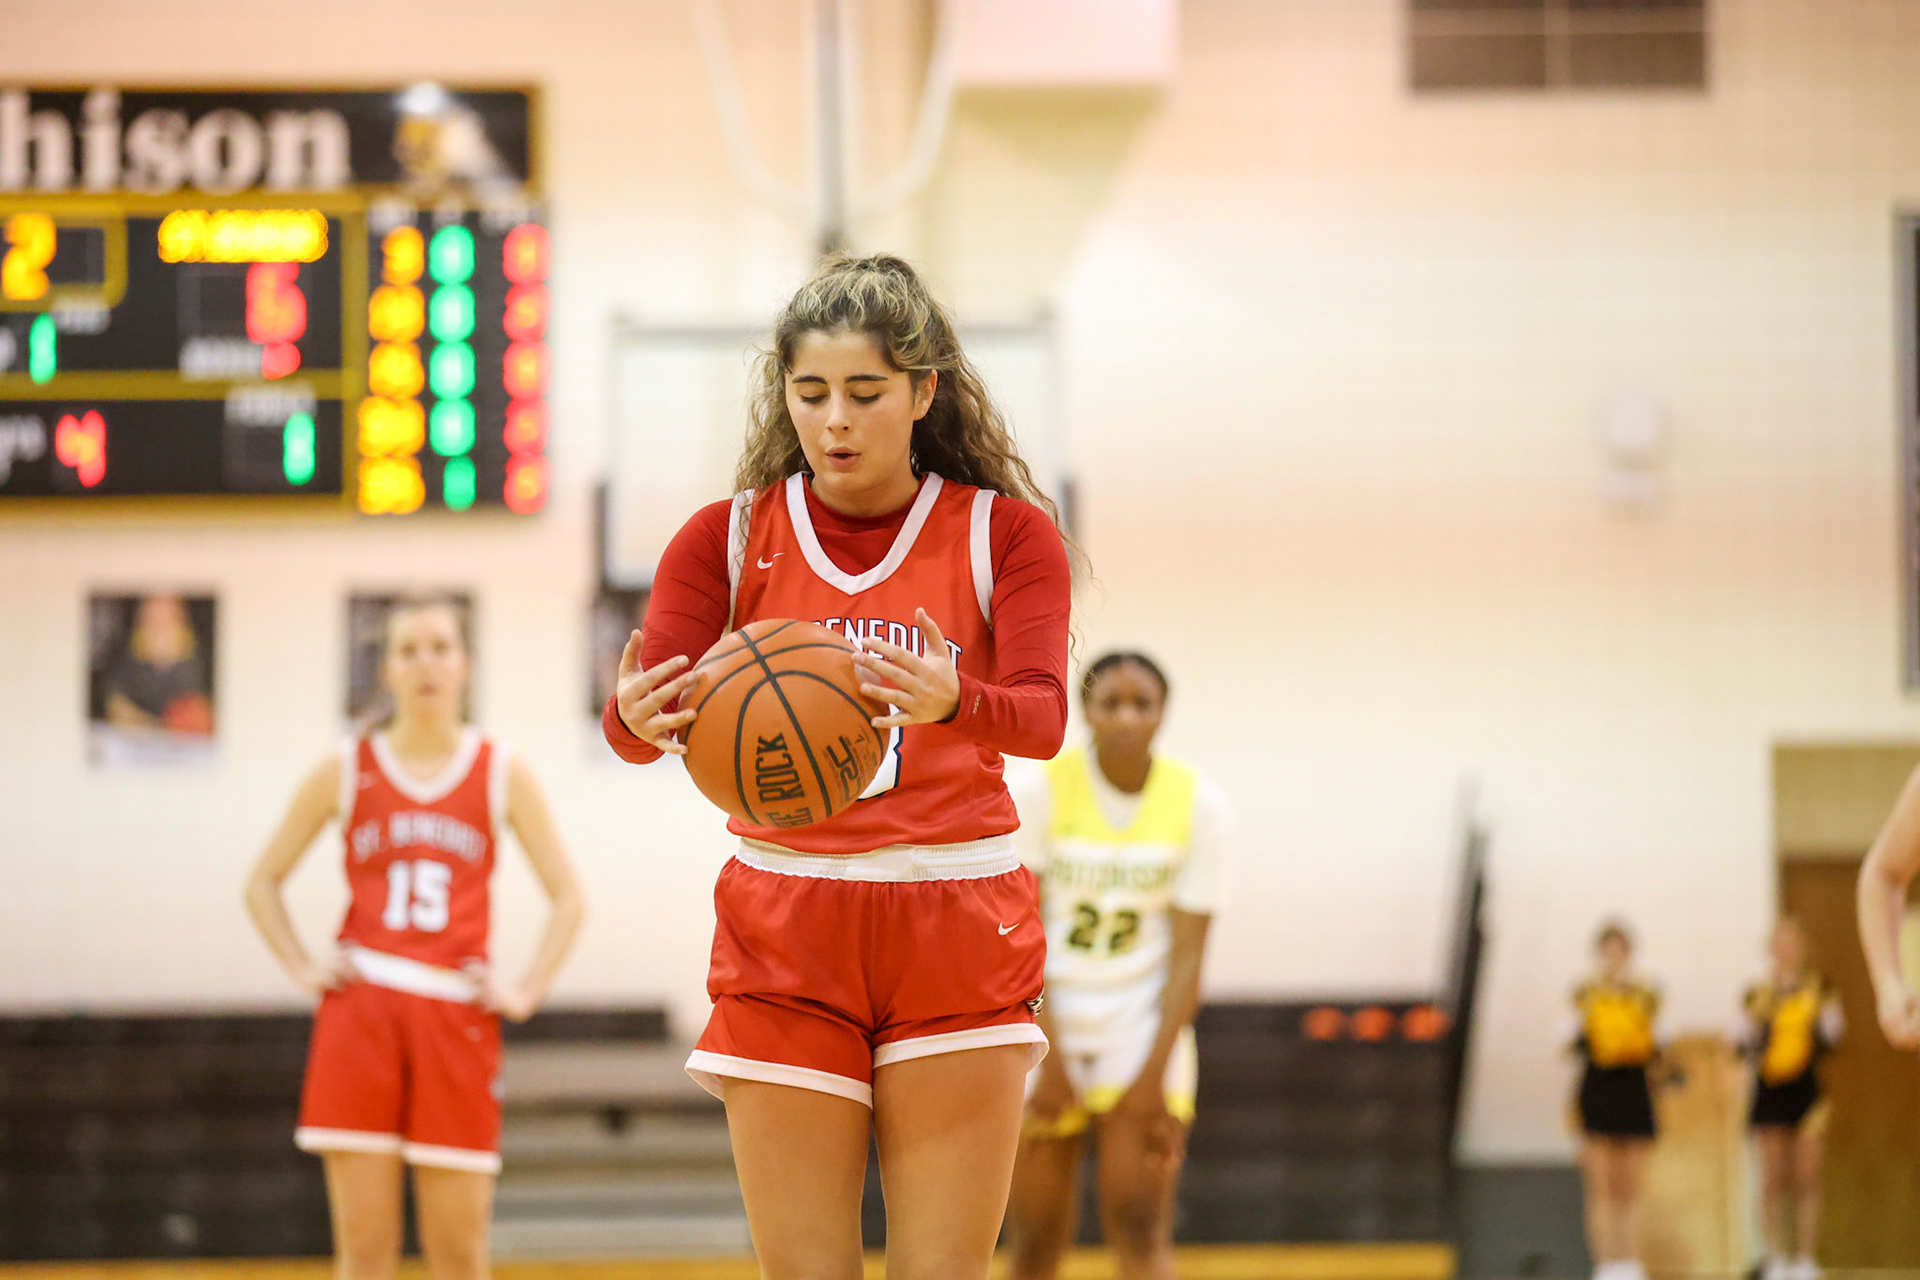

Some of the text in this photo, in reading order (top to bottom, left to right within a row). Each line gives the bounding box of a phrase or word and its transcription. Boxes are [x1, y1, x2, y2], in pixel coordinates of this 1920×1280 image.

[755, 732, 806, 803] ROCK
[382, 857, 453, 933] 15
[1066, 900, 1141, 956] 22
